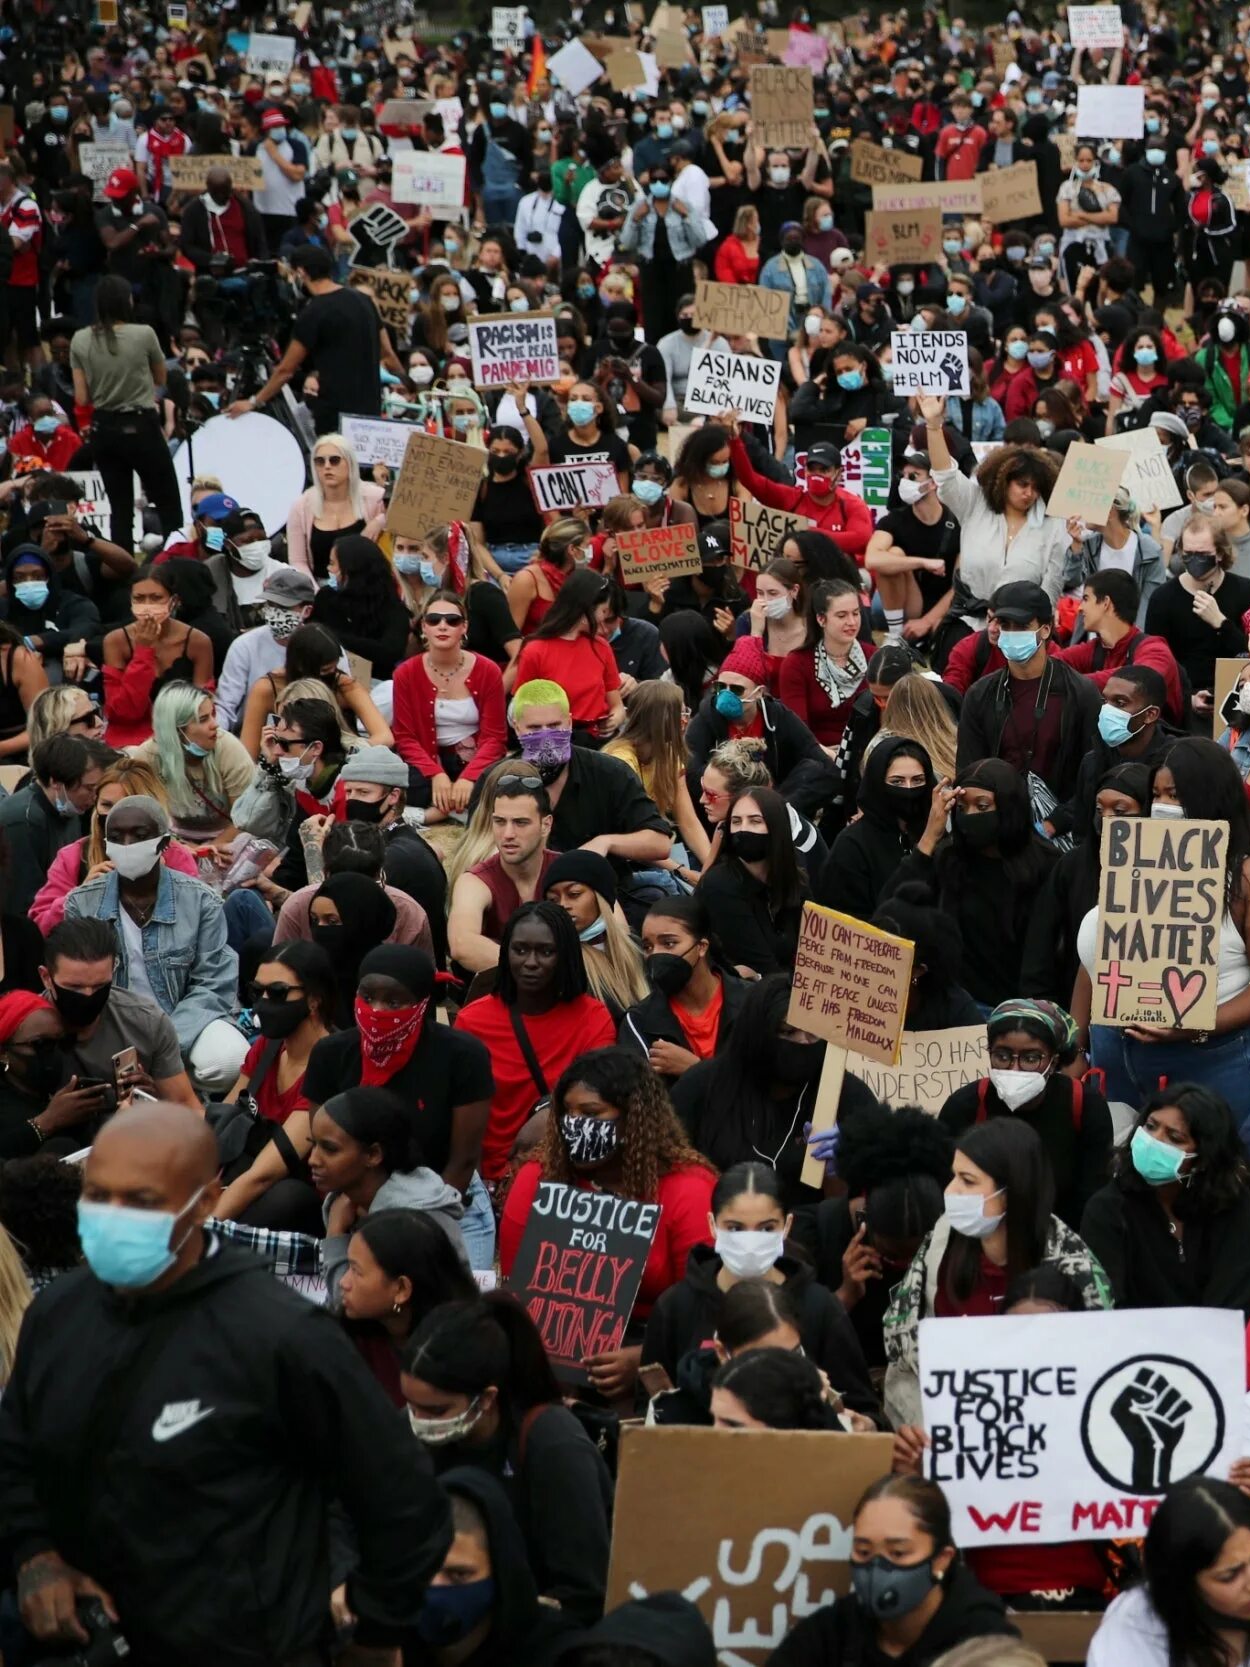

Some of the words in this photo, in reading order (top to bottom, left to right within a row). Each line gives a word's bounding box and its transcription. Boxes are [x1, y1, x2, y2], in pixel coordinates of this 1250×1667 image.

[752, 68, 809, 94] BLACK
[855, 160, 887, 183] LIVES
[862, 146, 902, 167] BLACK
[892, 222, 920, 240] BLM
[703, 286, 709, 303] I
[718, 288, 782, 316] STAND
[696, 306, 743, 326] WITH
[746, 313, 787, 334] YOU
[477, 323, 540, 359] RACISM
[541, 324, 553, 340] IS
[498, 348, 528, 360] THE
[481, 359, 555, 384] PANDEMIC
[698, 352, 776, 385] ASIANS
[897, 349, 937, 365] NOW
[705, 376, 731, 392] FOR
[894, 371, 942, 387] #BLM
[690, 387, 735, 409] BLACK
[735, 396, 774, 418] LIVES
[409, 447, 433, 466] NOT
[416, 431, 438, 447] IT
[443, 442, 466, 459] IS
[402, 462, 422, 475] TO
[425, 465, 443, 481] BE
[862, 428, 890, 506] FILMED
[1074, 456, 1112, 474] BLACK
[1136, 453, 1169, 480] NOT
[454, 488, 470, 503] BE
[537, 474, 550, 508] I
[729, 498, 797, 534] BLACK
[619, 525, 673, 550] LEARN
[674, 523, 694, 540] TO
[730, 523, 778, 550] LIVE
[632, 542, 685, 564] LOVE
[644, 561, 668, 574] LIVES
[668, 557, 701, 571] MATTER
[1109, 819, 1225, 871] BLACK
[802, 909, 828, 941] YOU
[831, 924, 864, 949] CAN'T
[1101, 922, 1216, 966] MATTER
[799, 935, 826, 957] PEACE
[830, 948, 852, 967] FROM
[853, 958, 896, 979] FREEDOM
[796, 952, 836, 976] BECAUSE
[840, 970, 852, 982] NO
[853, 974, 871, 989] ONE
[877, 983, 899, 1000] CAN
[793, 971, 810, 991] BE
[812, 979, 829, 995] AT
[830, 983, 861, 1003] PEACE
[867, 995, 899, 1014] UNLESS
[799, 991, 815, 1011] HE
[820, 998, 841, 1016] HAS
[847, 1006, 888, 1030] FREEDOM
[911, 1040, 941, 1068] SO
[947, 1035, 990, 1065] HAR
[532, 1180, 659, 1240] JUSTICE
[569, 1228, 607, 1253] FOR
[525, 1240, 635, 1307] BELLY
[924, 1366, 1077, 1399] JUSTICE
[954, 1395, 1025, 1425] FOR
[930, 1422, 1047, 1457] BLACK
[930, 1450, 1039, 1481] LIVES
[967, 1500, 1042, 1532] WE
[1071, 1498, 1160, 1531] MATT
